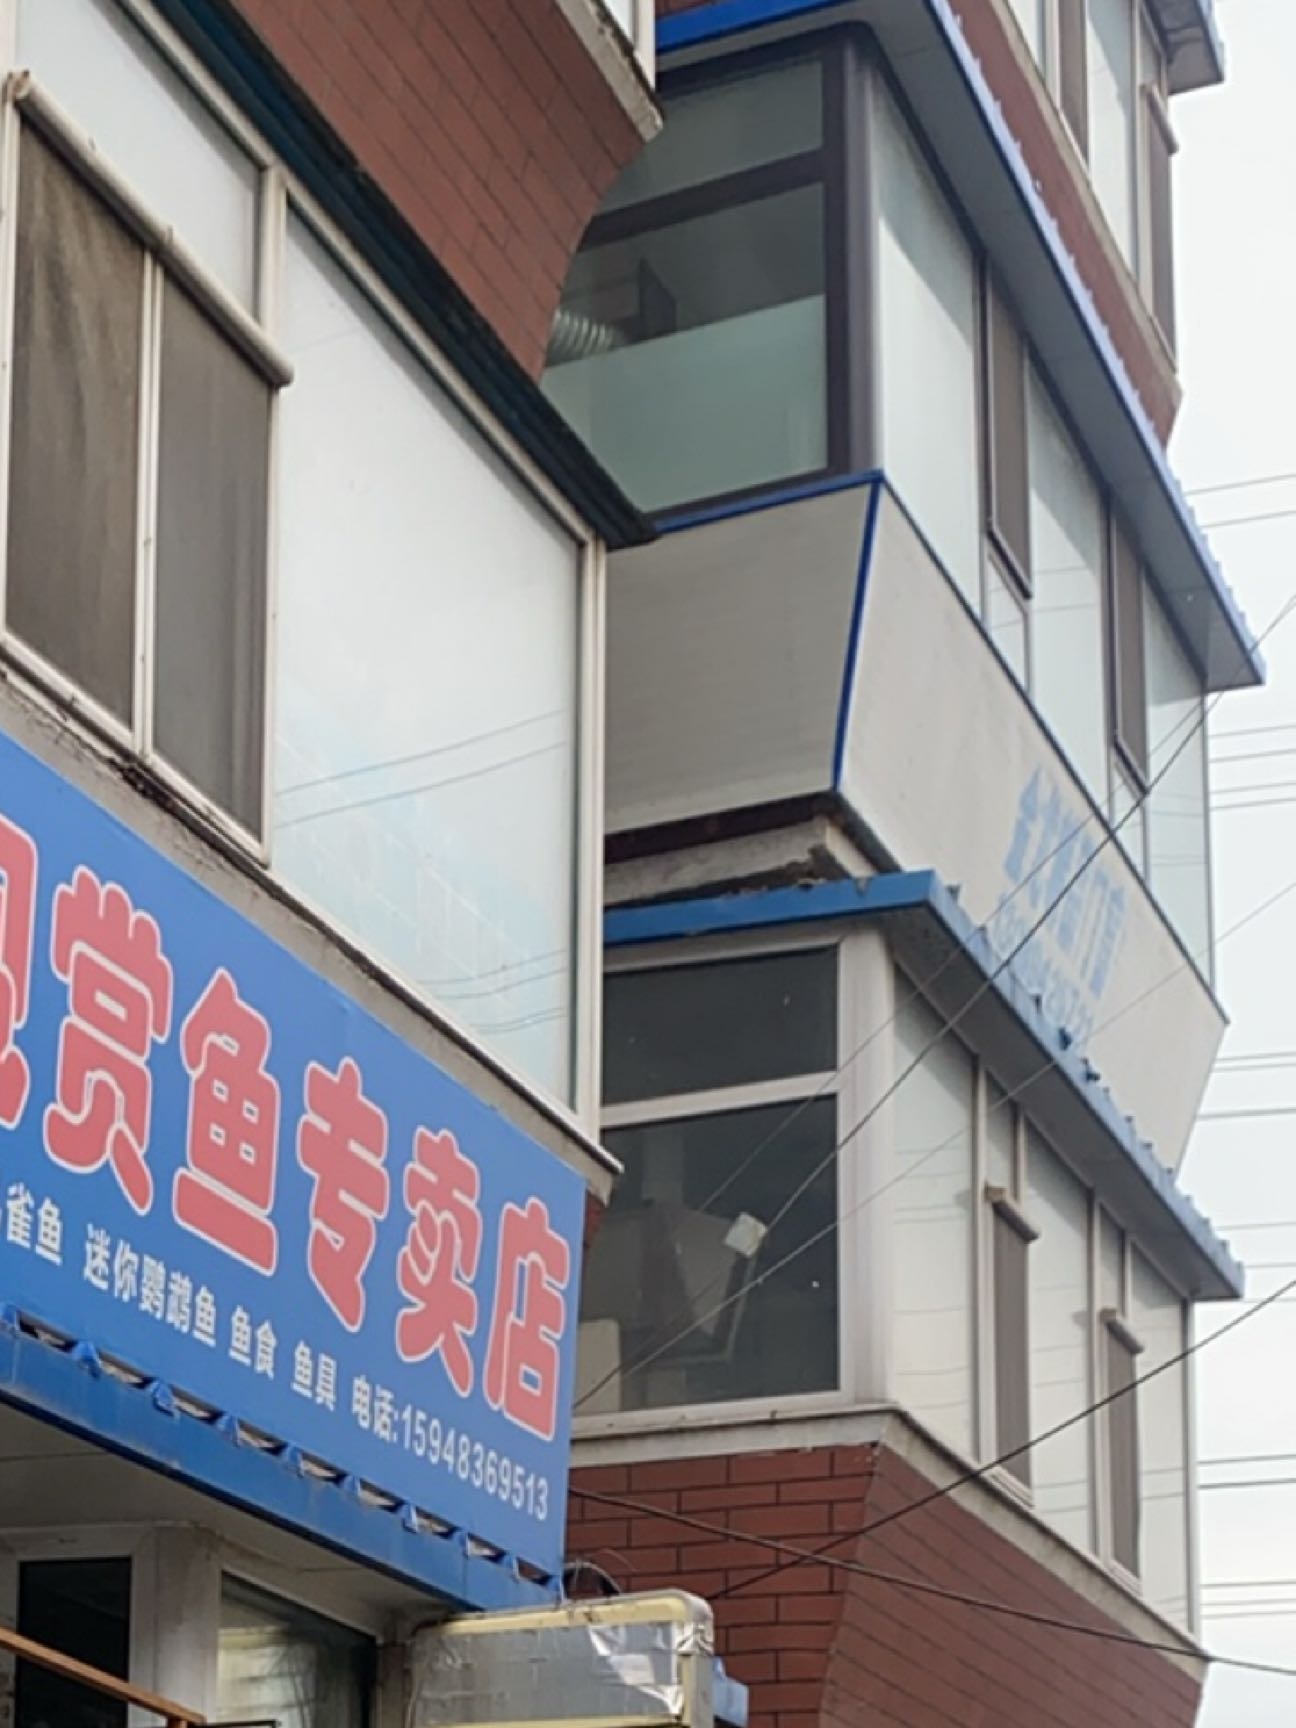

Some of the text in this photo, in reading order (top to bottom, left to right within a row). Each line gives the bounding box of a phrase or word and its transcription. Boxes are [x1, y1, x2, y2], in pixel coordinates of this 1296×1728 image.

[83, 1223, 217, 1348] 迷你鹦鹉鱼
[229, 1305, 278, 1380] 鱼食
[291, 1340, 337, 1411] 鱼具
